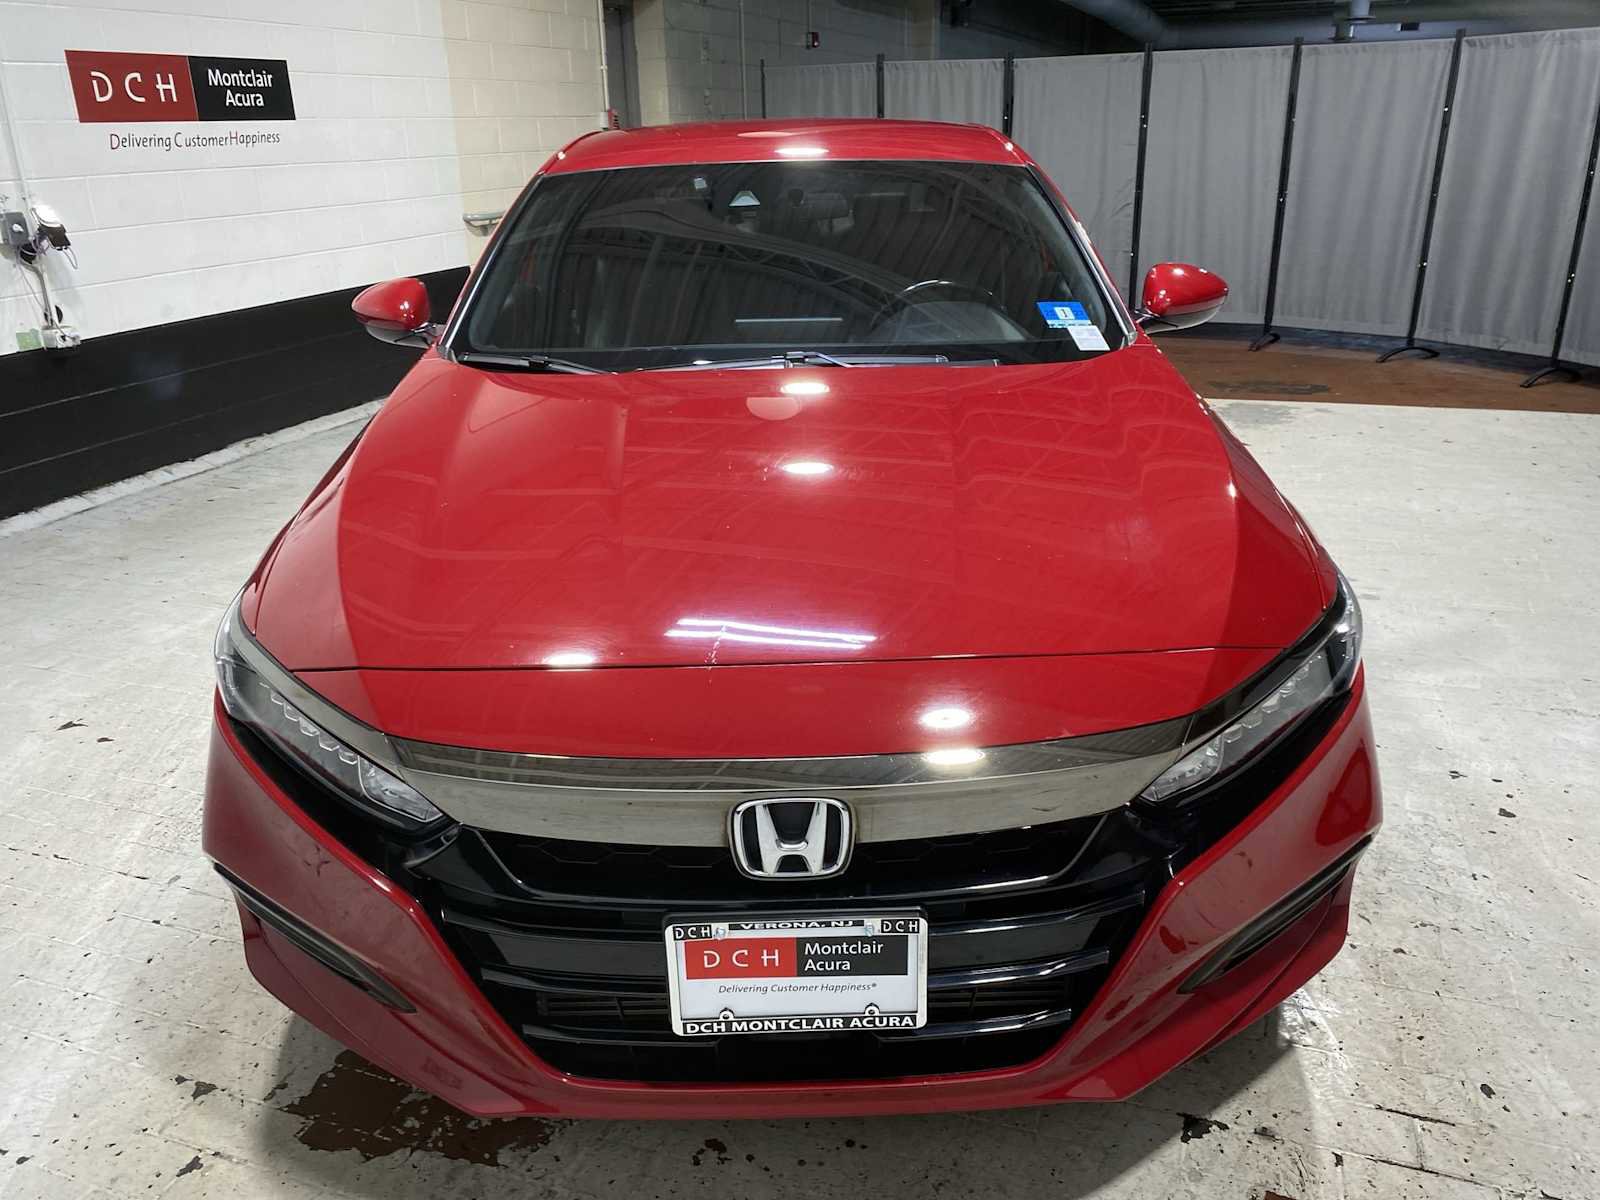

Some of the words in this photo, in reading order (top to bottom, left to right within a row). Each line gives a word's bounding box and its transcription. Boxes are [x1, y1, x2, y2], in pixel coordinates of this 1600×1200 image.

[208, 69, 273, 88] Montclair
[225, 90, 264, 107] Acura
[109, 133, 172, 151] Delivering
[831, 919, 854, 927] NJ
[804, 941, 884, 955] Montclair
[804, 959, 851, 971] Acura
[718, 984, 768, 995] Delivering
[770, 983, 819, 992] Customer
[686, 1022, 726, 1034] DCH
[731, 1017, 844, 1033] MONTCLAIR
[849, 1015, 914, 1028] ACURA
